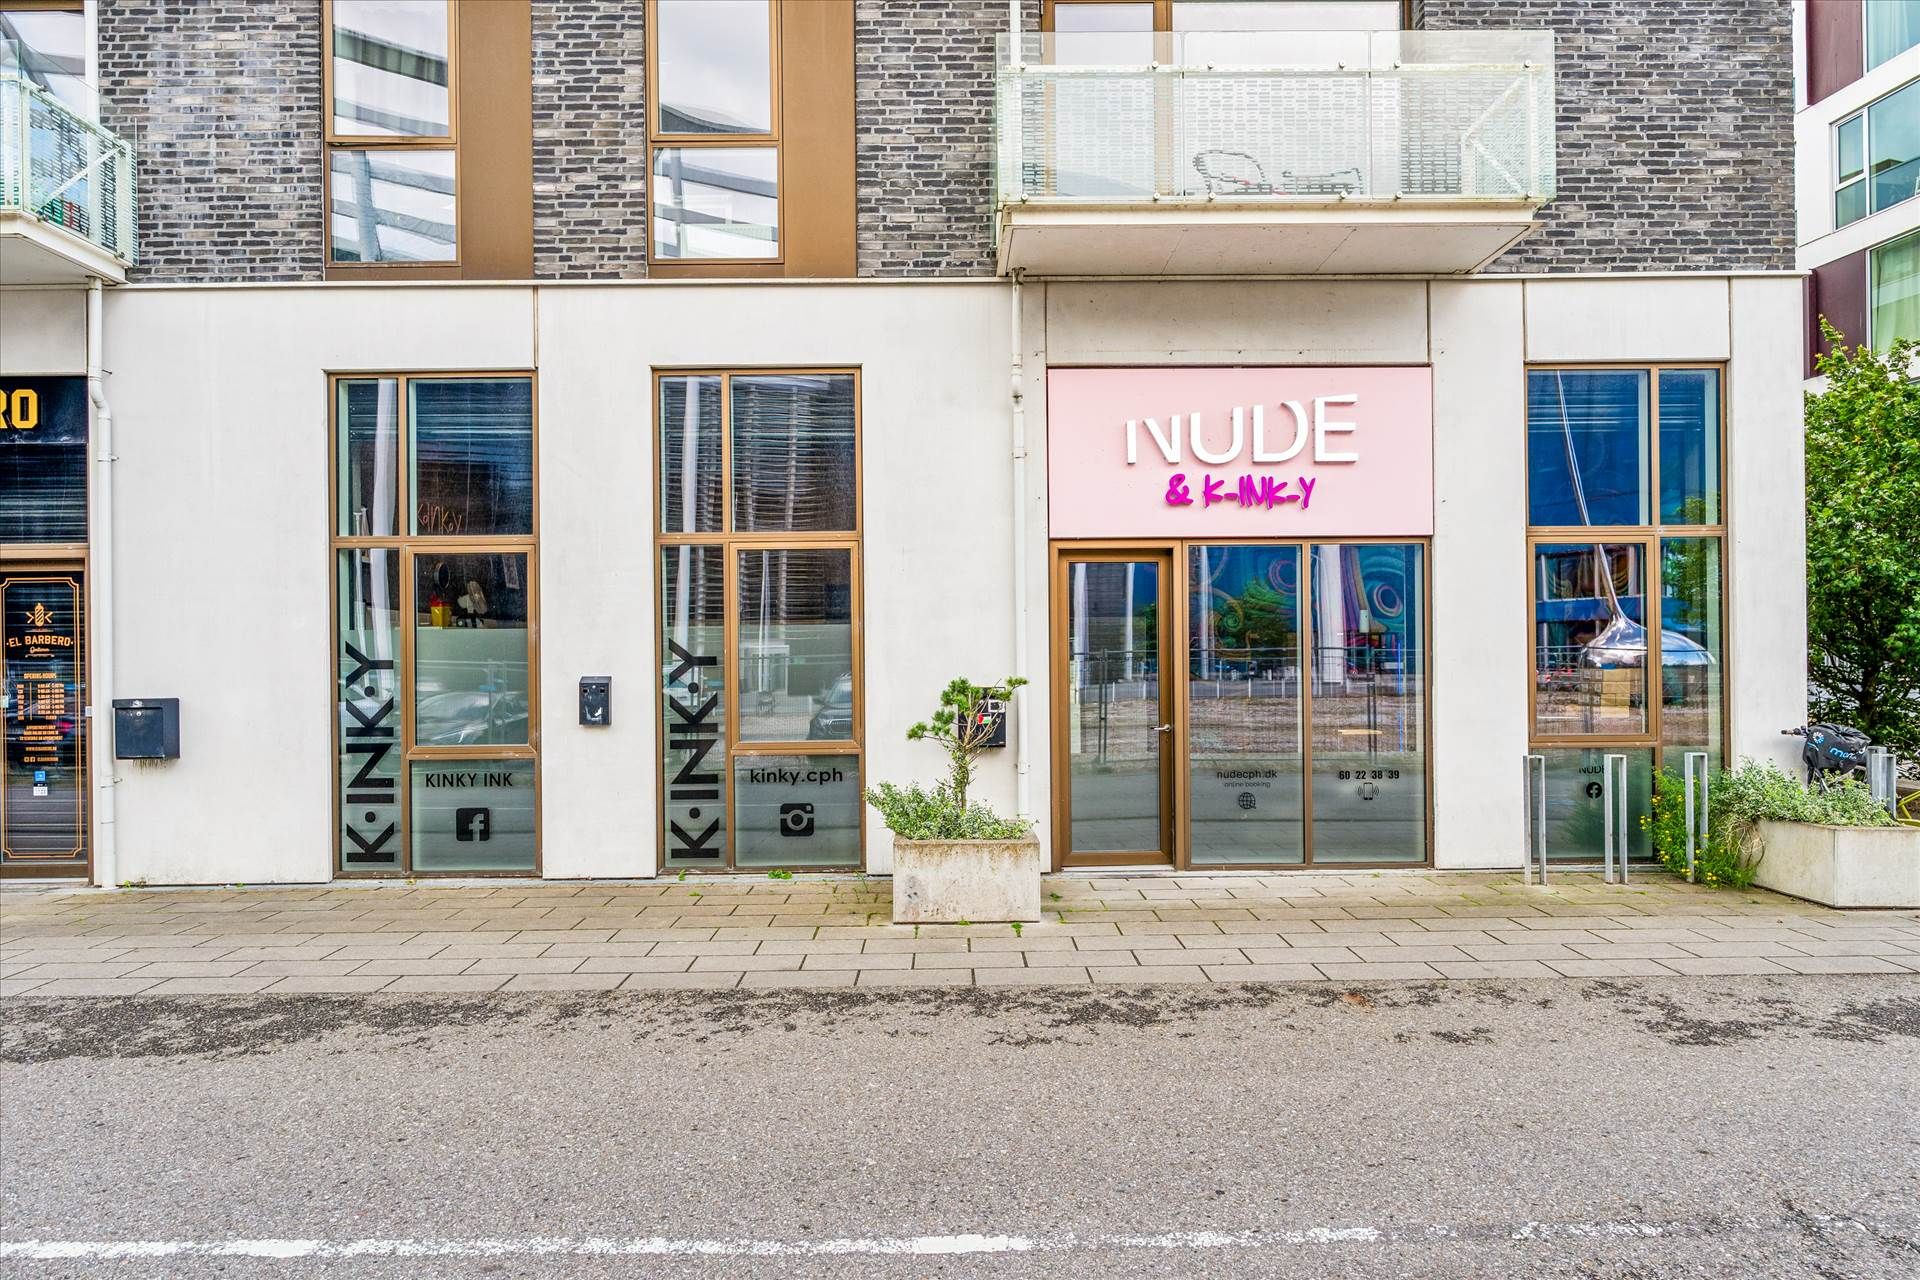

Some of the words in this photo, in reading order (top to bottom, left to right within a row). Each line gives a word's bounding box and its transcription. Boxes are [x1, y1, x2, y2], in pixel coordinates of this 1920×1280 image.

[0, 388, 38, 430] O
[1126, 393, 1359, 464] NUDE
[1164, 473, 1194, 506] &
[8, 637, 22, 648] EL
[25, 635, 71, 647] BARBERO
[425, 773, 477, 788] KINKY
[483, 772, 513, 787] INK
[750, 767, 843, 786] kinky.cph
[1216, 768, 1278, 781] nudecph.dk
[1338, 770, 1351, 780] 60
[1356, 770, 1366, 780] 22
[1371, 770, 1383, 780] 38
[1388, 769, 1400, 780] 39
